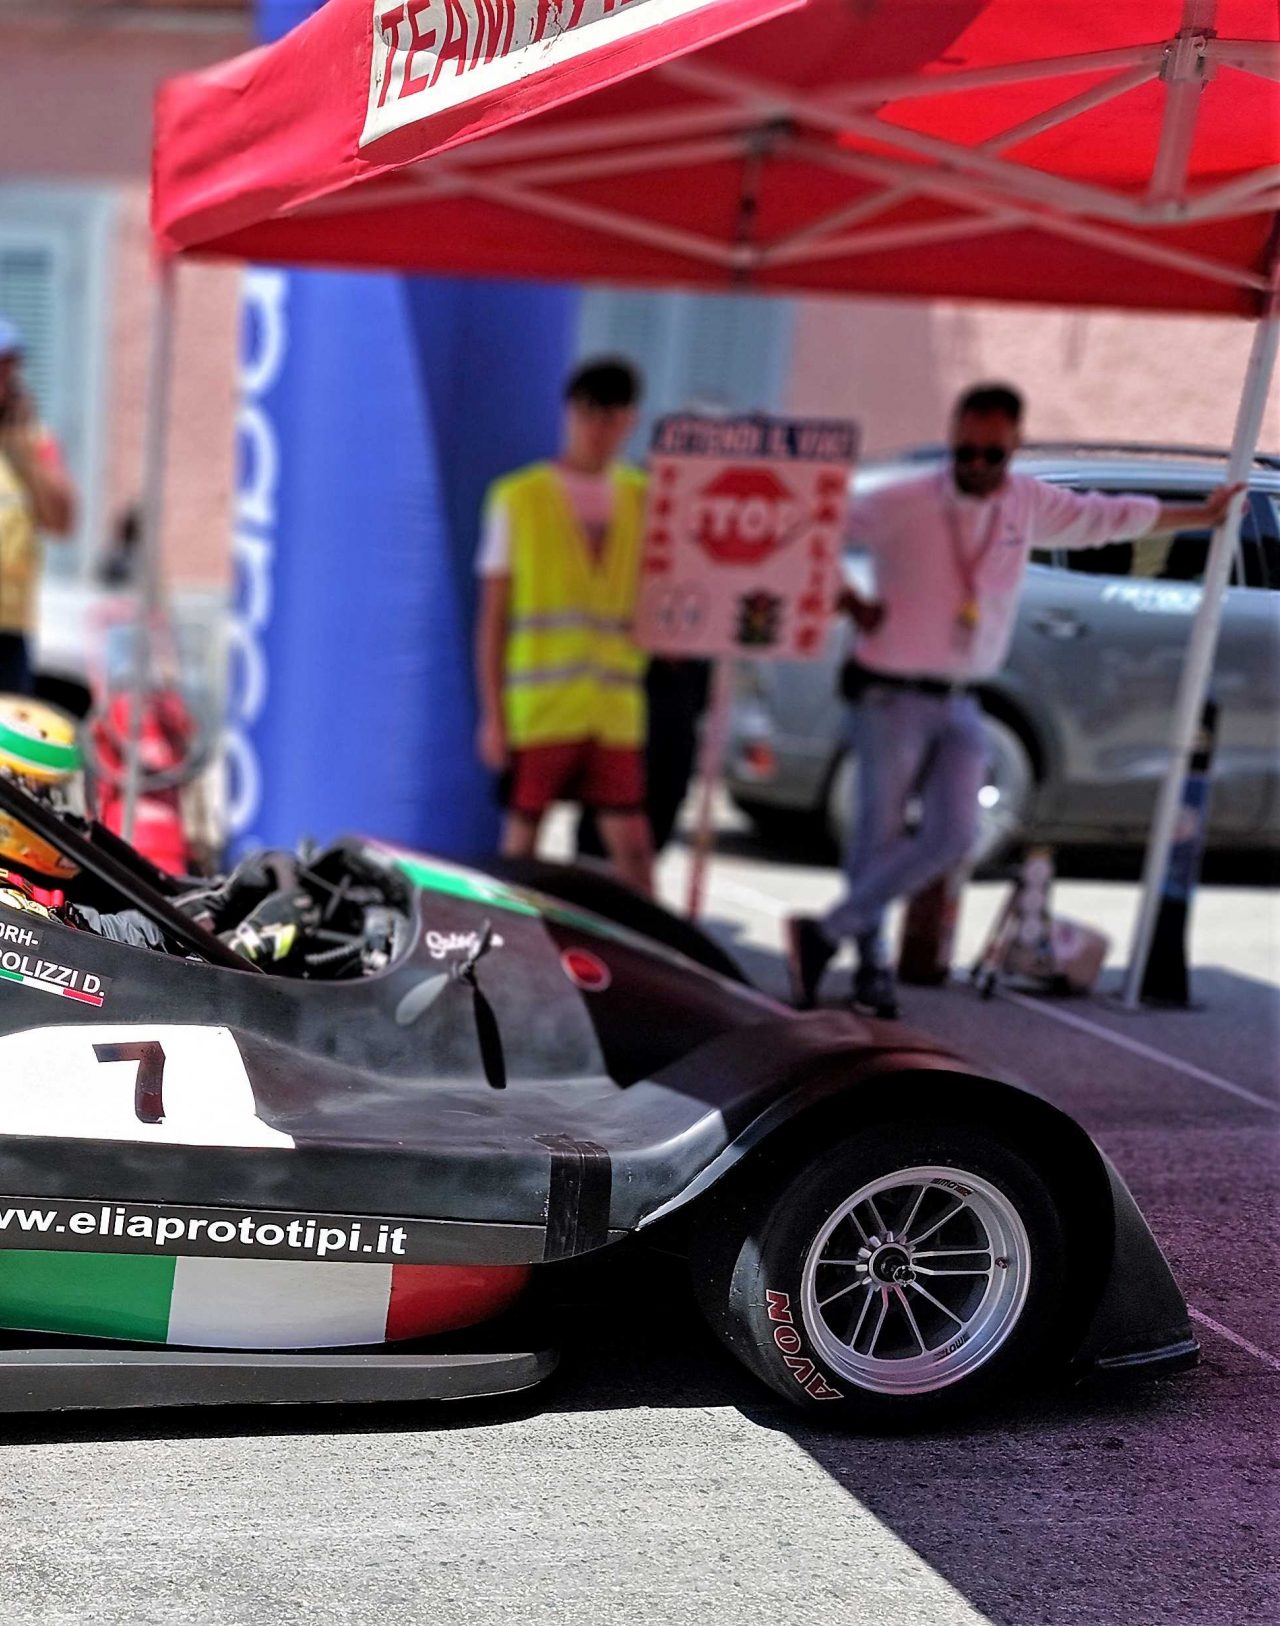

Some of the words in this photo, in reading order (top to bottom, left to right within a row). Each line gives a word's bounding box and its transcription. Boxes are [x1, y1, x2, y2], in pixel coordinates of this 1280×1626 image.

[377, 0, 516, 108] TEAM
[82, 973, 105, 997] D.
[91, 1040, 166, 1124] 7
[765, 1288, 845, 1400] AVON
